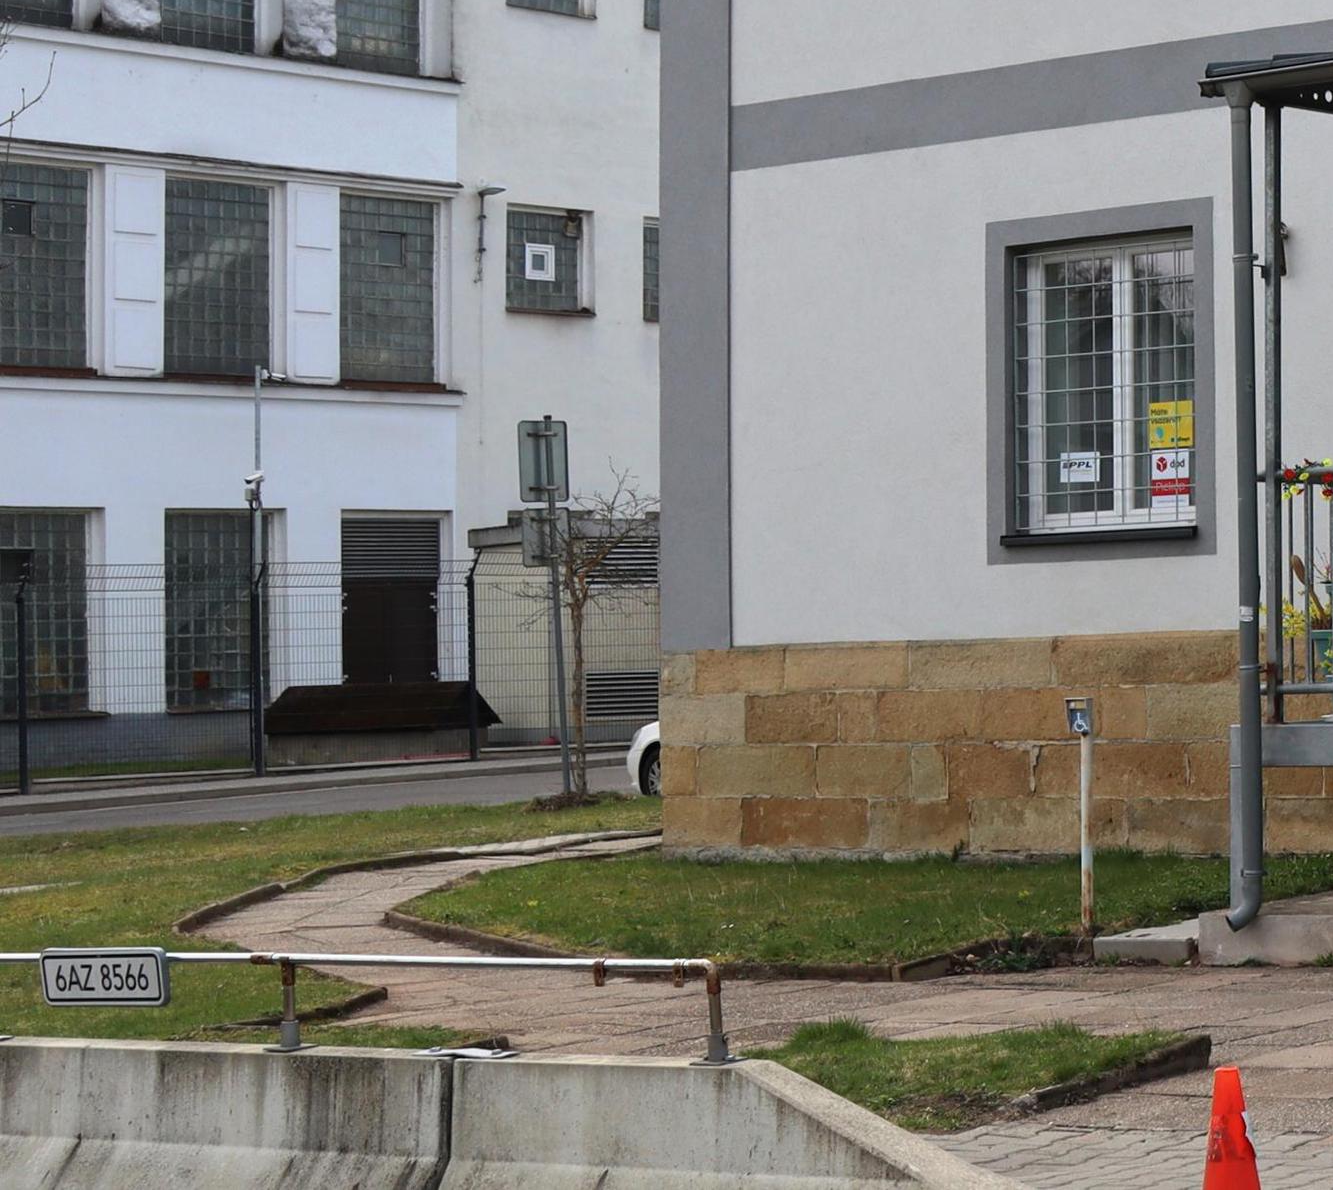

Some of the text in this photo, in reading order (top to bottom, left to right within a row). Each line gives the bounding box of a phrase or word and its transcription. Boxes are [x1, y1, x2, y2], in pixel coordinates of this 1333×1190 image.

[1069, 461, 1093, 469] PPL
[56, 962, 149, 992] 6AZ 8566
